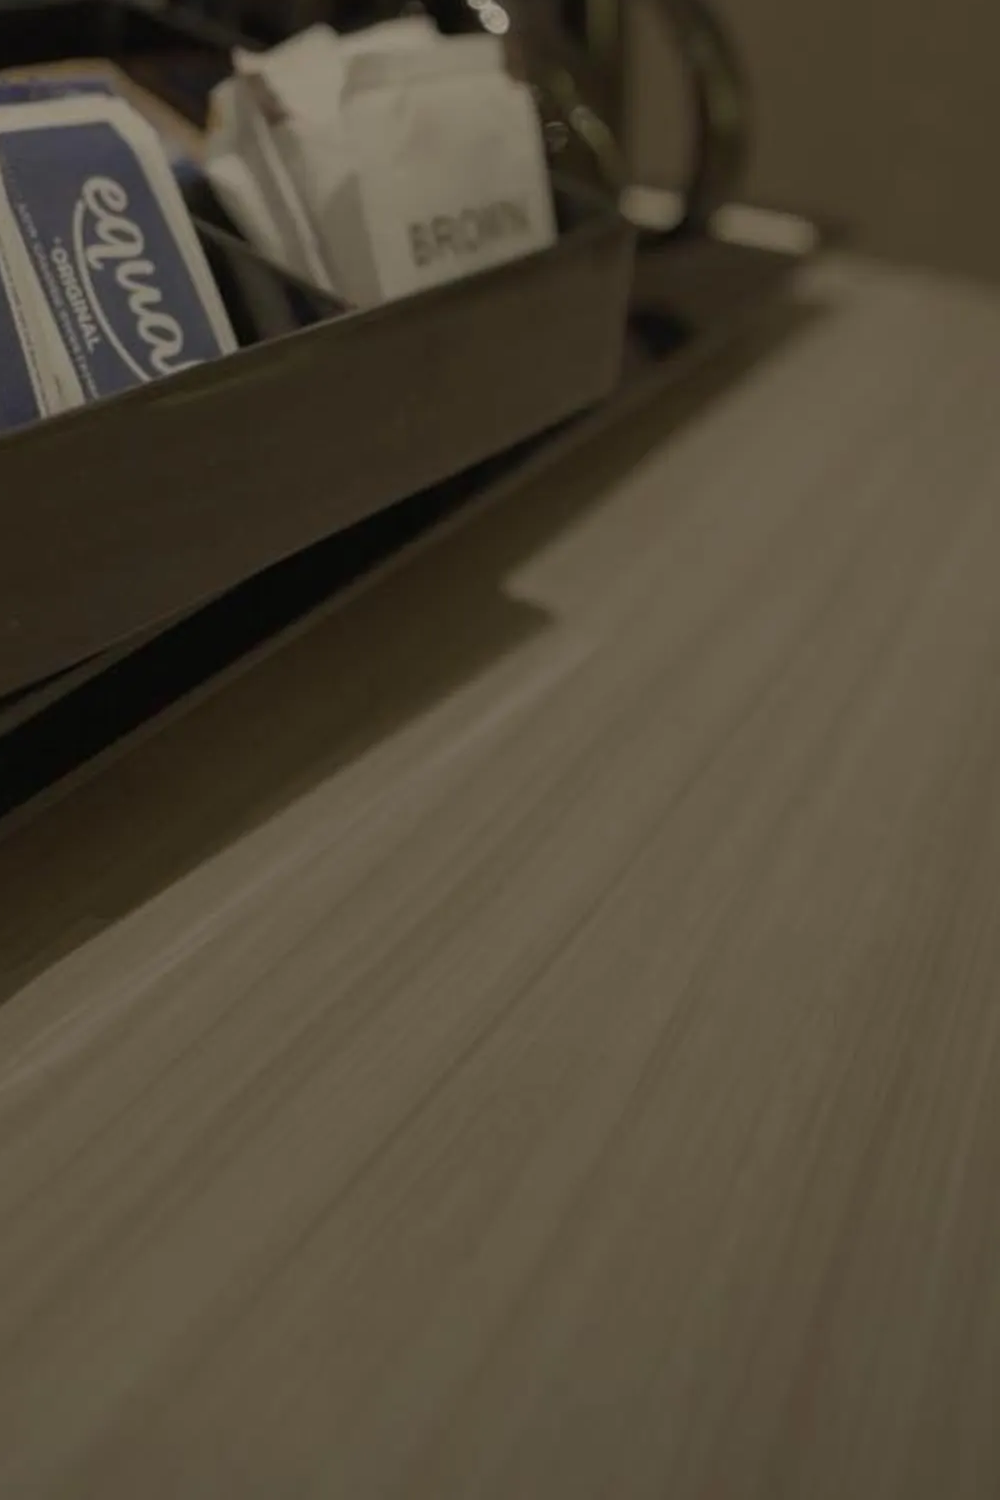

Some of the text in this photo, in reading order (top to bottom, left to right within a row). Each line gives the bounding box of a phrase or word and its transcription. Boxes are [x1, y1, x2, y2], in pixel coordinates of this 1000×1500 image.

[82, 176, 206, 376] equa
[408, 199, 529, 268] BROWN
[50, 247, 101, 355] ORIGINAL
